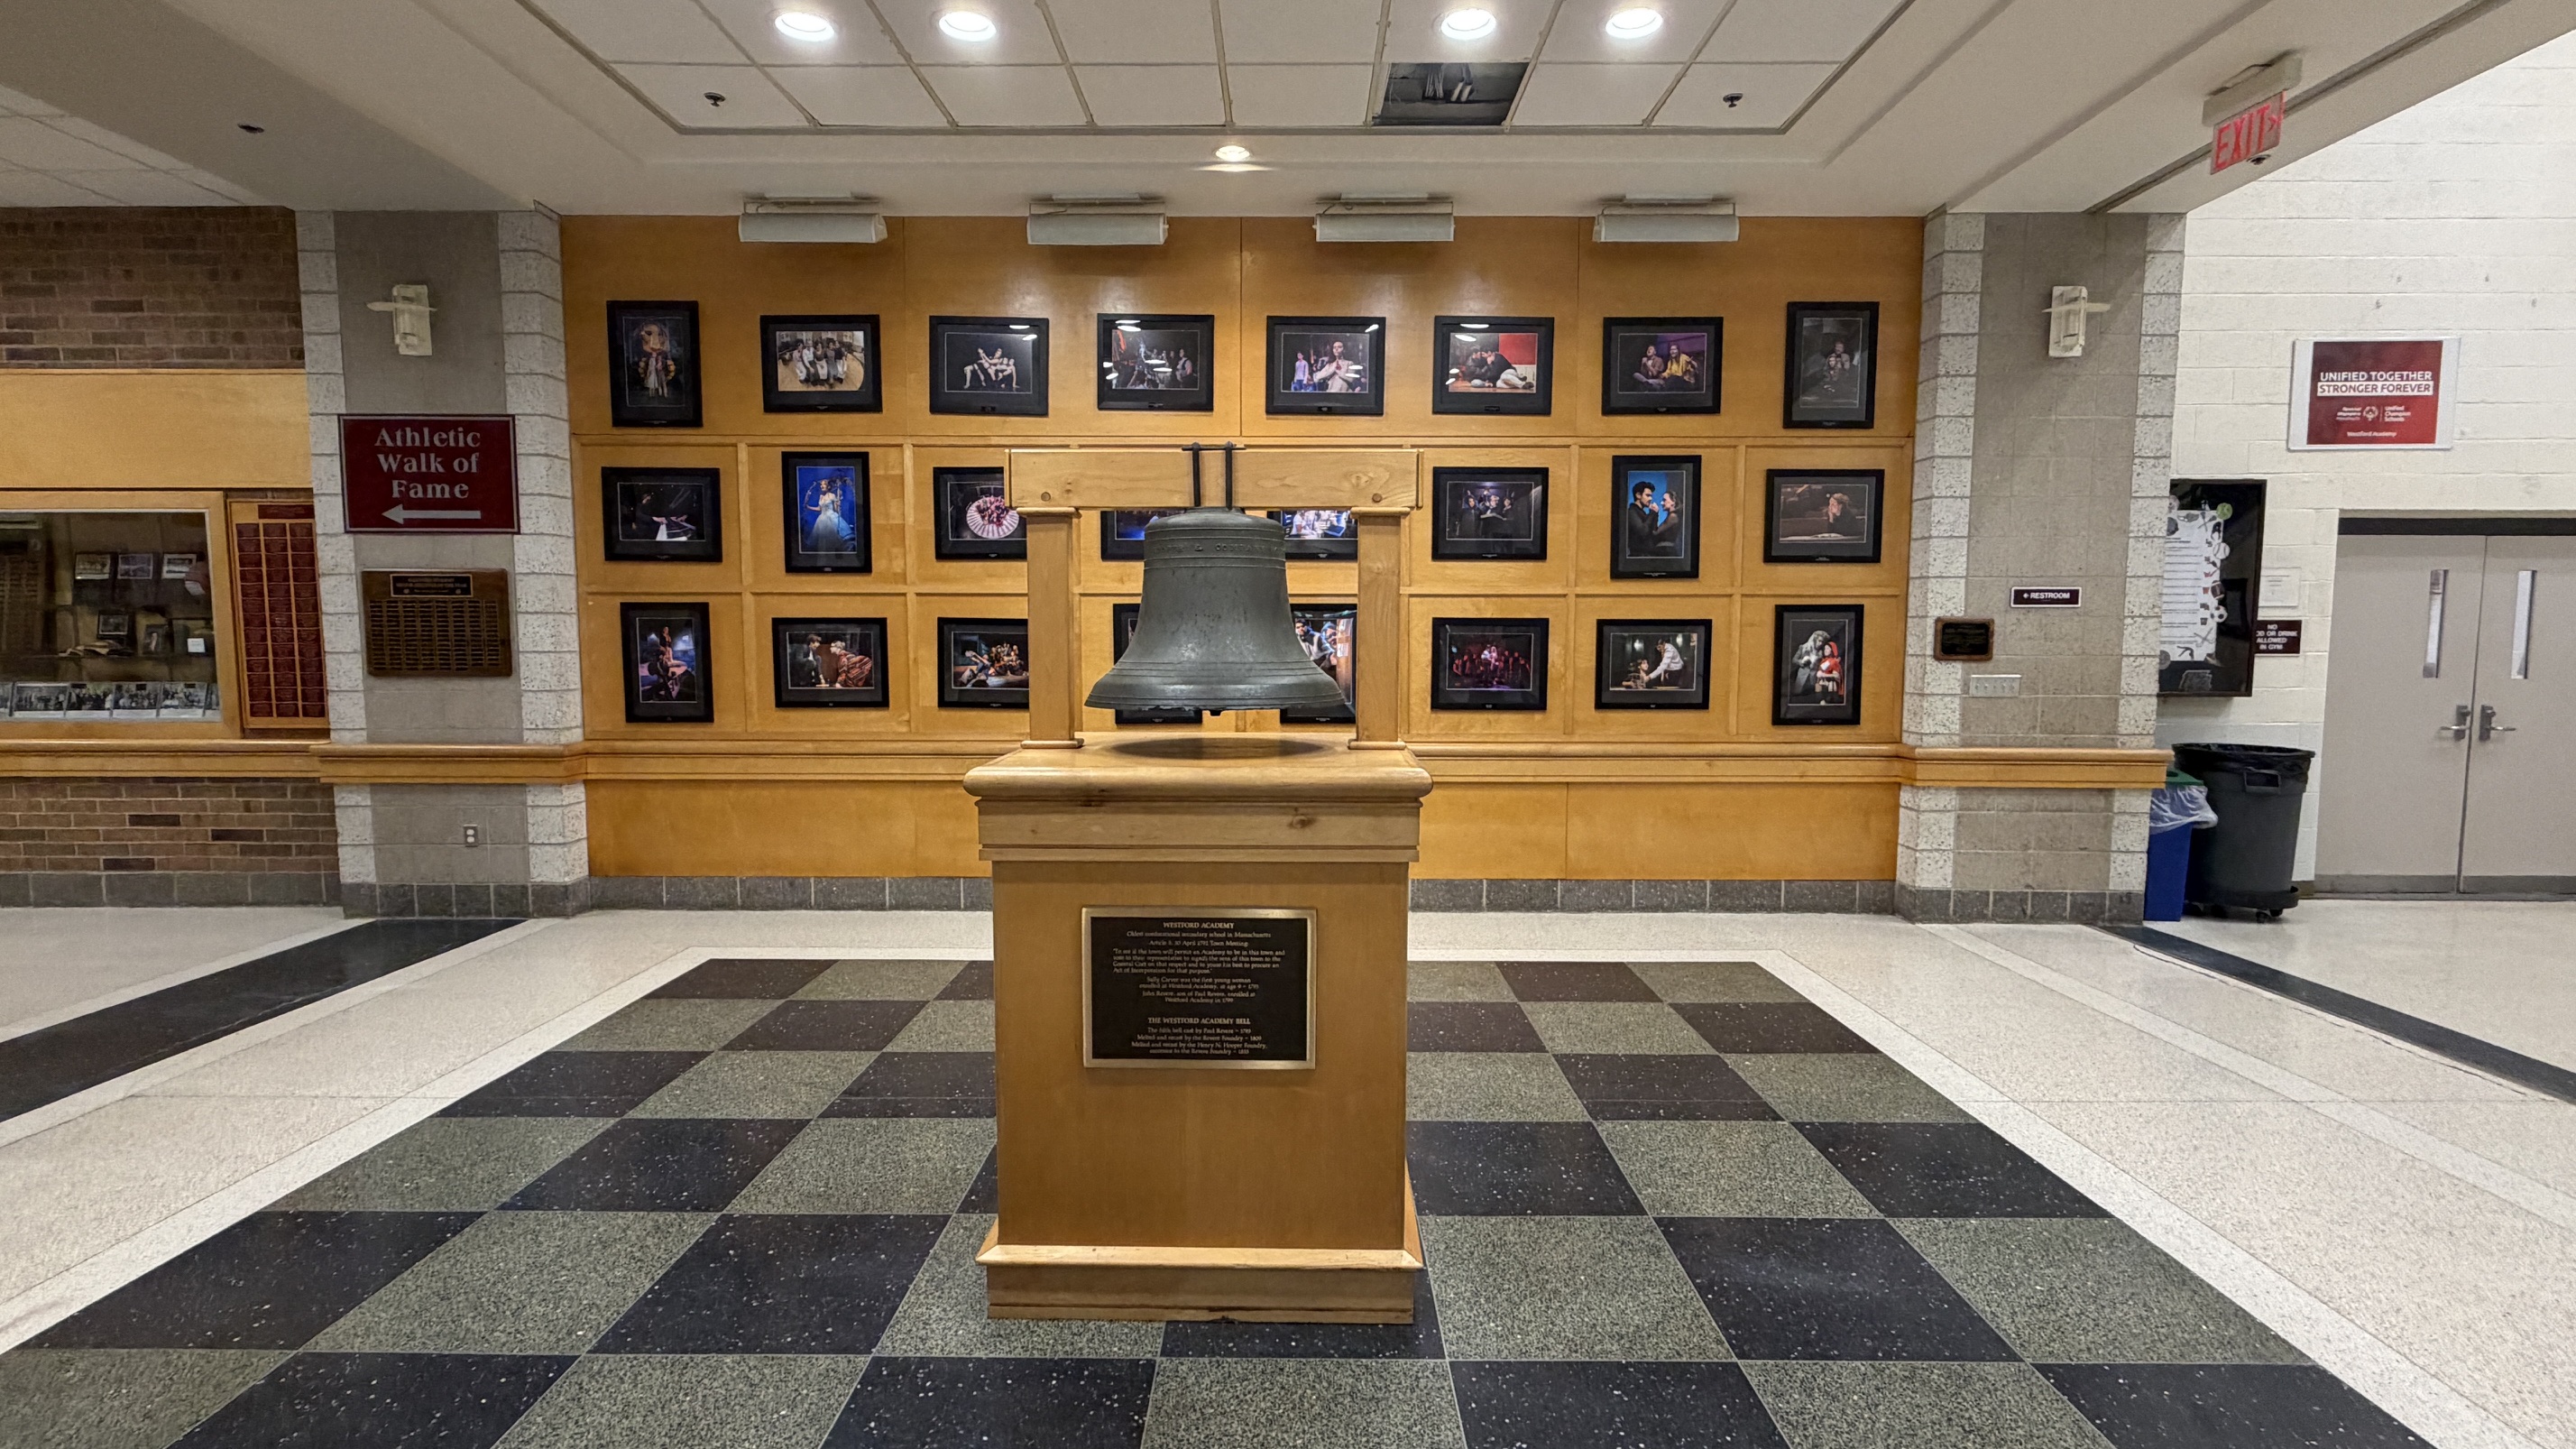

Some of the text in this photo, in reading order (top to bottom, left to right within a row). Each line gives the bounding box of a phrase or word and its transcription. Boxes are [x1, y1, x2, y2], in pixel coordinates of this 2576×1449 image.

[2215, 104, 2270, 171] EXIT
[2320, 371, 2433, 382] UNIFIED TOGETHER
[2320, 383, 2431, 393] STRONGER FOREVER
[374, 428, 481, 448] Athletic
[377, 452, 479, 474] Walk of
[391, 480, 469, 499] Fame
